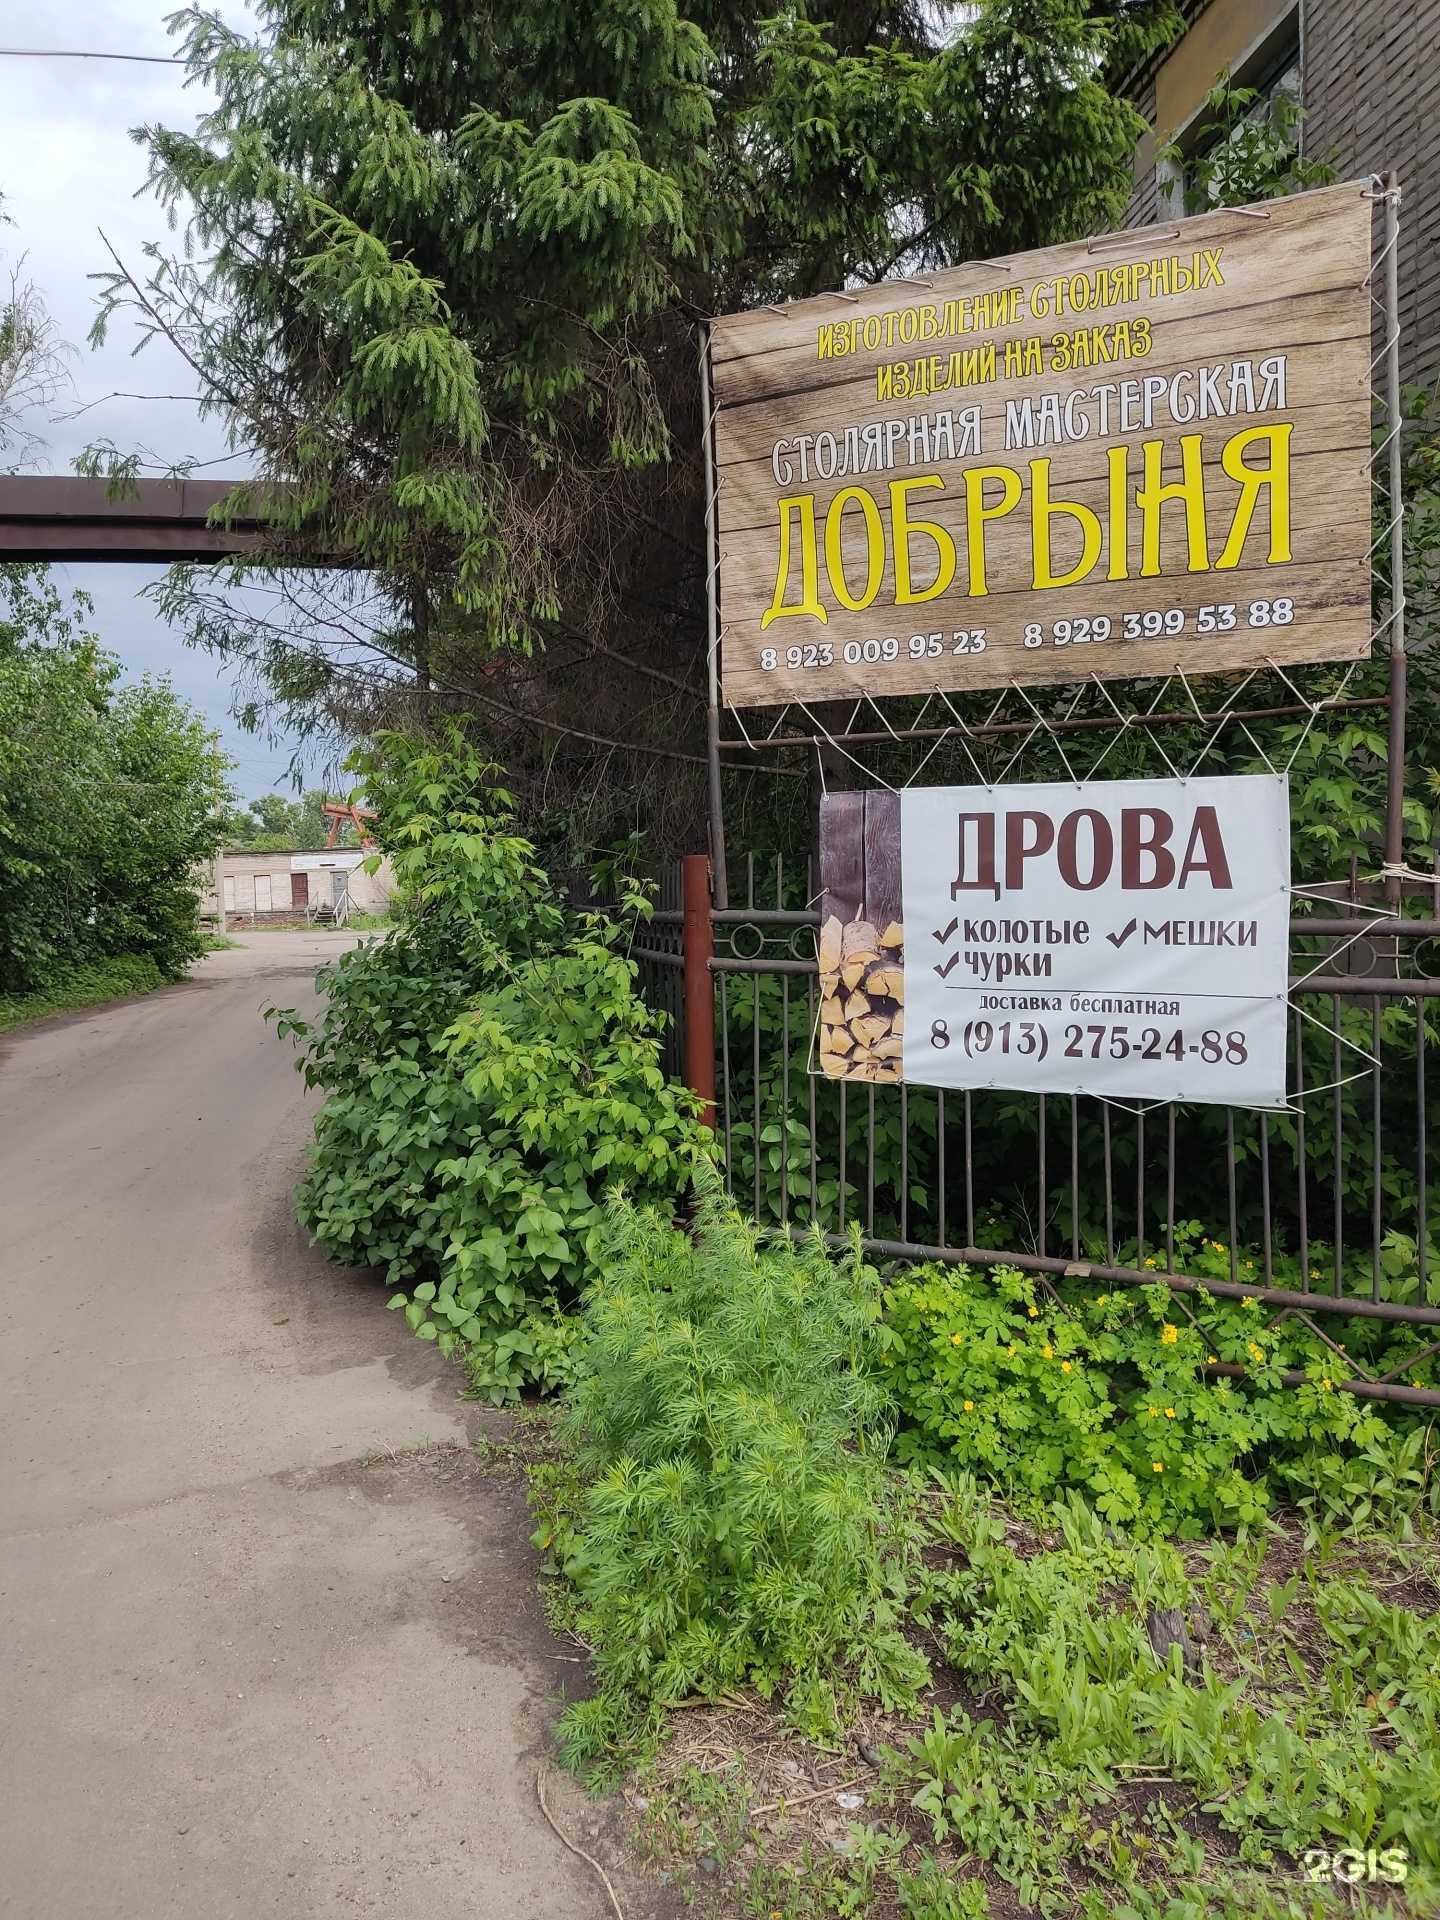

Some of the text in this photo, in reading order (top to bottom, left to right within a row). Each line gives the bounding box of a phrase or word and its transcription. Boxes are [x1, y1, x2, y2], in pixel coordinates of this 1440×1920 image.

[817, 247, 1225, 360] ИЗГОТОВЛЕНИЕ СТОЛЯРНЫХ
[876, 318, 1153, 402] ИЗДЕЛИЙ НА ЗАКАЗ
[771, 354, 1288, 486] СТОЛЯРНАЯ МАСТЕРСКАЯ
[759, 423, 1294, 630] ДОБРЫНЯ
[1023, 598, 1294, 648] 8 929 399 53 88
[760, 629, 987, 671] 8 923 009 95 23
[950, 805, 1233, 902] ДРОВА
[1143, 919, 1258, 947] МЕШКИ
[964, 951, 1053, 982] чурки
[978, 992, 1181, 1016] доставка бесплатная
[930, 1019, 1249, 1065] 8 (913) 275-24-88
